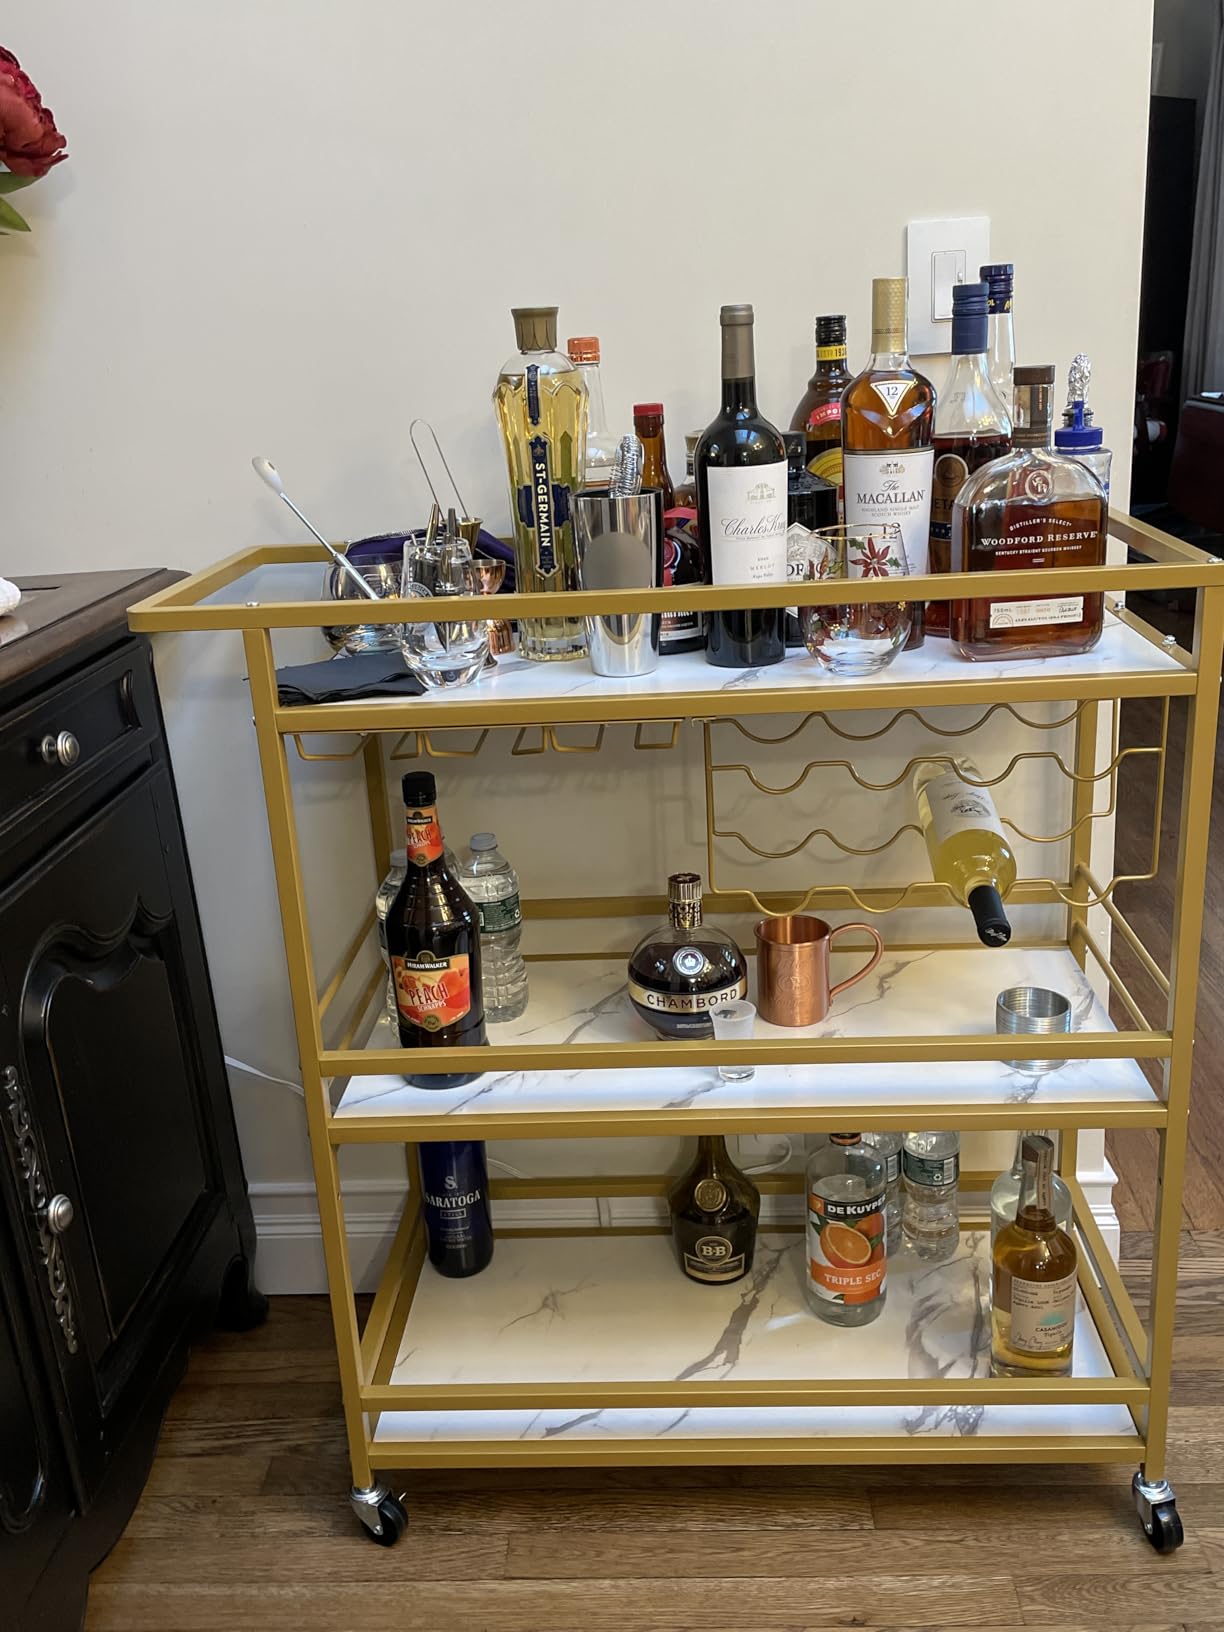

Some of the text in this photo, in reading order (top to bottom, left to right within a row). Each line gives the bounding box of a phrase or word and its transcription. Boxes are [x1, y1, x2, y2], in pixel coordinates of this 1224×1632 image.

[886, 386, 899, 396] 12
[881, 480, 900, 492] The
[535, 463, 551, 547] ST-GERMAIN
[857, 490, 924, 505] MACALLAN
[720, 515, 767, 536] Charles
[881, 522, 901, 540] 12
[1009, 517, 1071, 531] DISTILLER'S SELECT
[981, 531, 1097, 546] WOODFORD RESERVE
[750, 562, 775, 571] MERLOT
[408, 981, 449, 1006] PEACH
[647, 988, 737, 1009] CHAMBORD
[417, 1000, 447, 1012] SCHNAPPS
[425, 1189, 481, 1208] SARATOGA
[827, 1204, 845, 1215] DE
[824, 1269, 881, 1286] TRIPLE SEC
